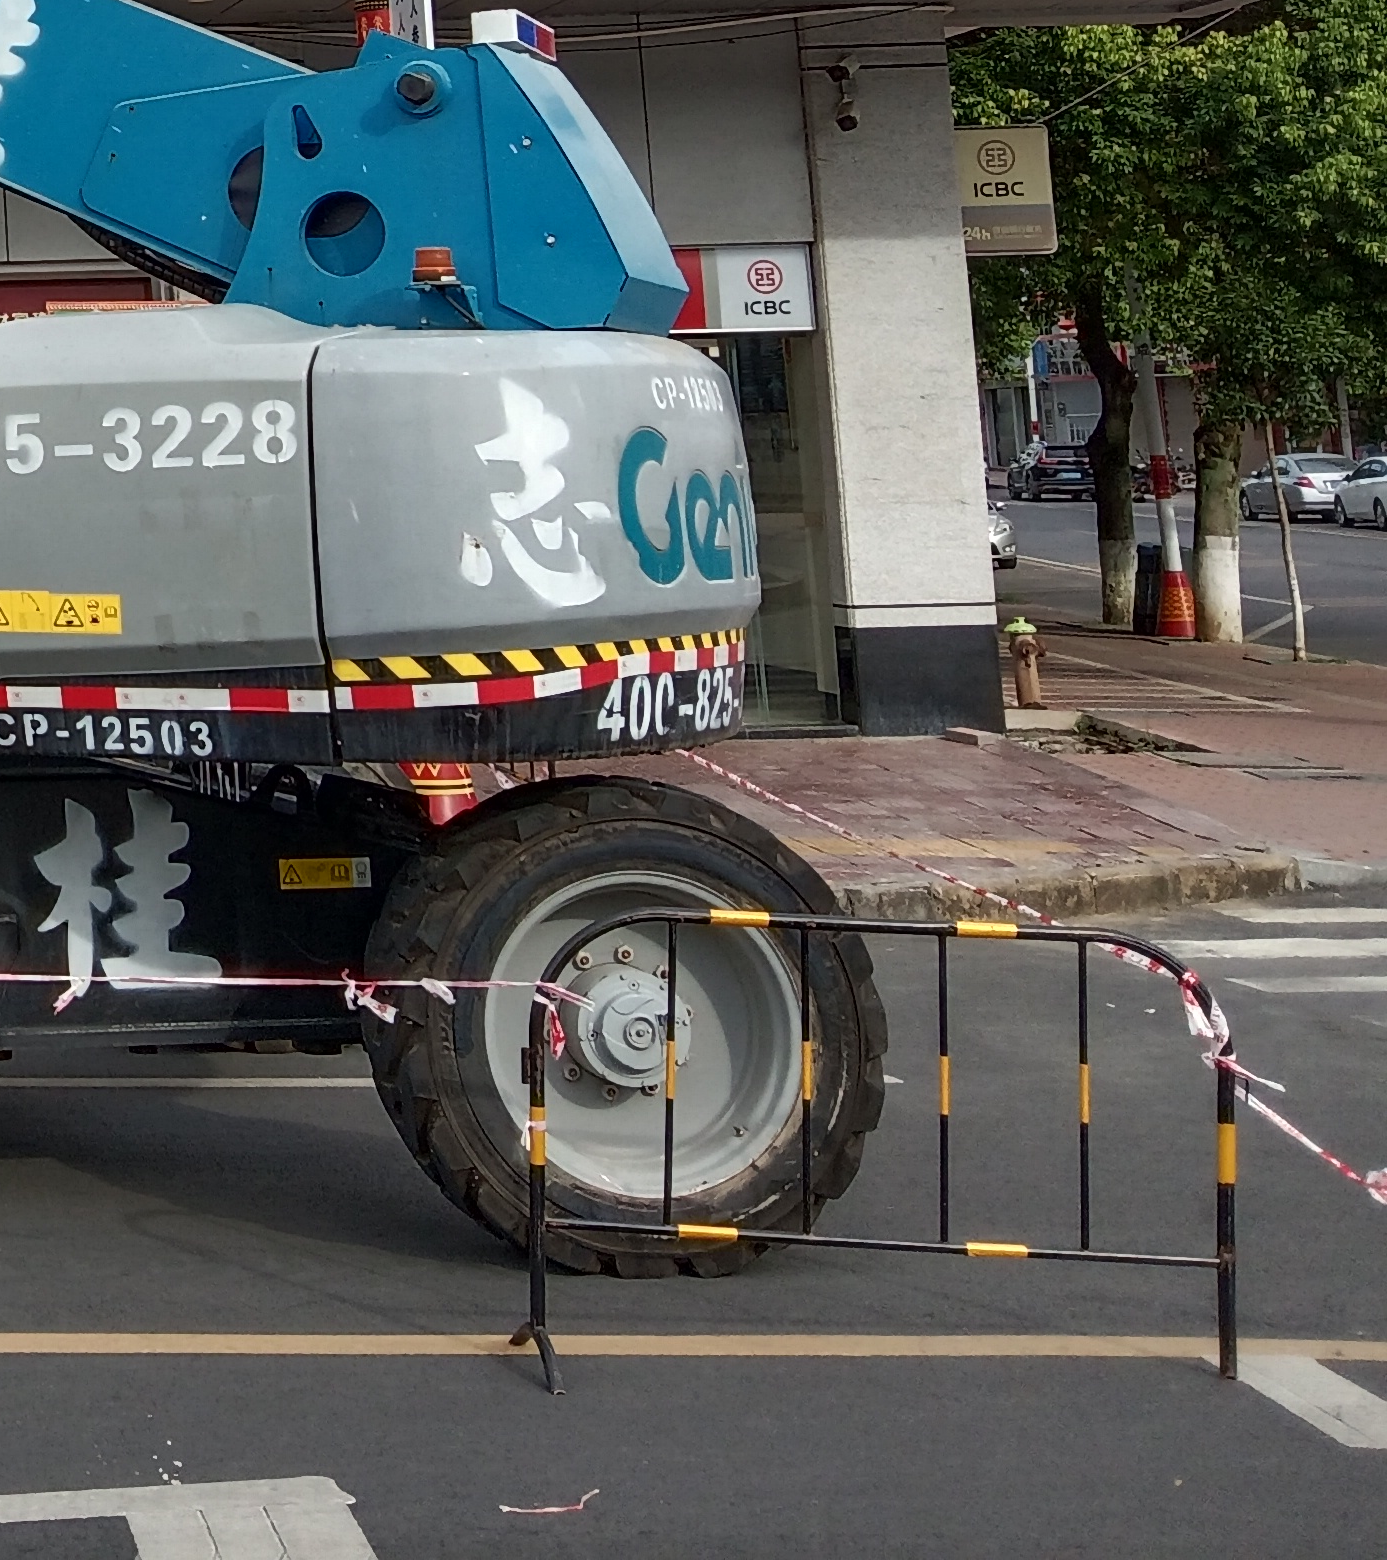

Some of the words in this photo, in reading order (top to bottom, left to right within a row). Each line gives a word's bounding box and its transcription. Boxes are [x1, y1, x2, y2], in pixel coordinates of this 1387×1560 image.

[973, 181, 1025, 197] ICBC
[743, 298, 792, 316] ICBC
[652, 376, 725, 413] CP-12503
[460, 376, 615, 608] 志
[32, 787, 224, 999] 桂
